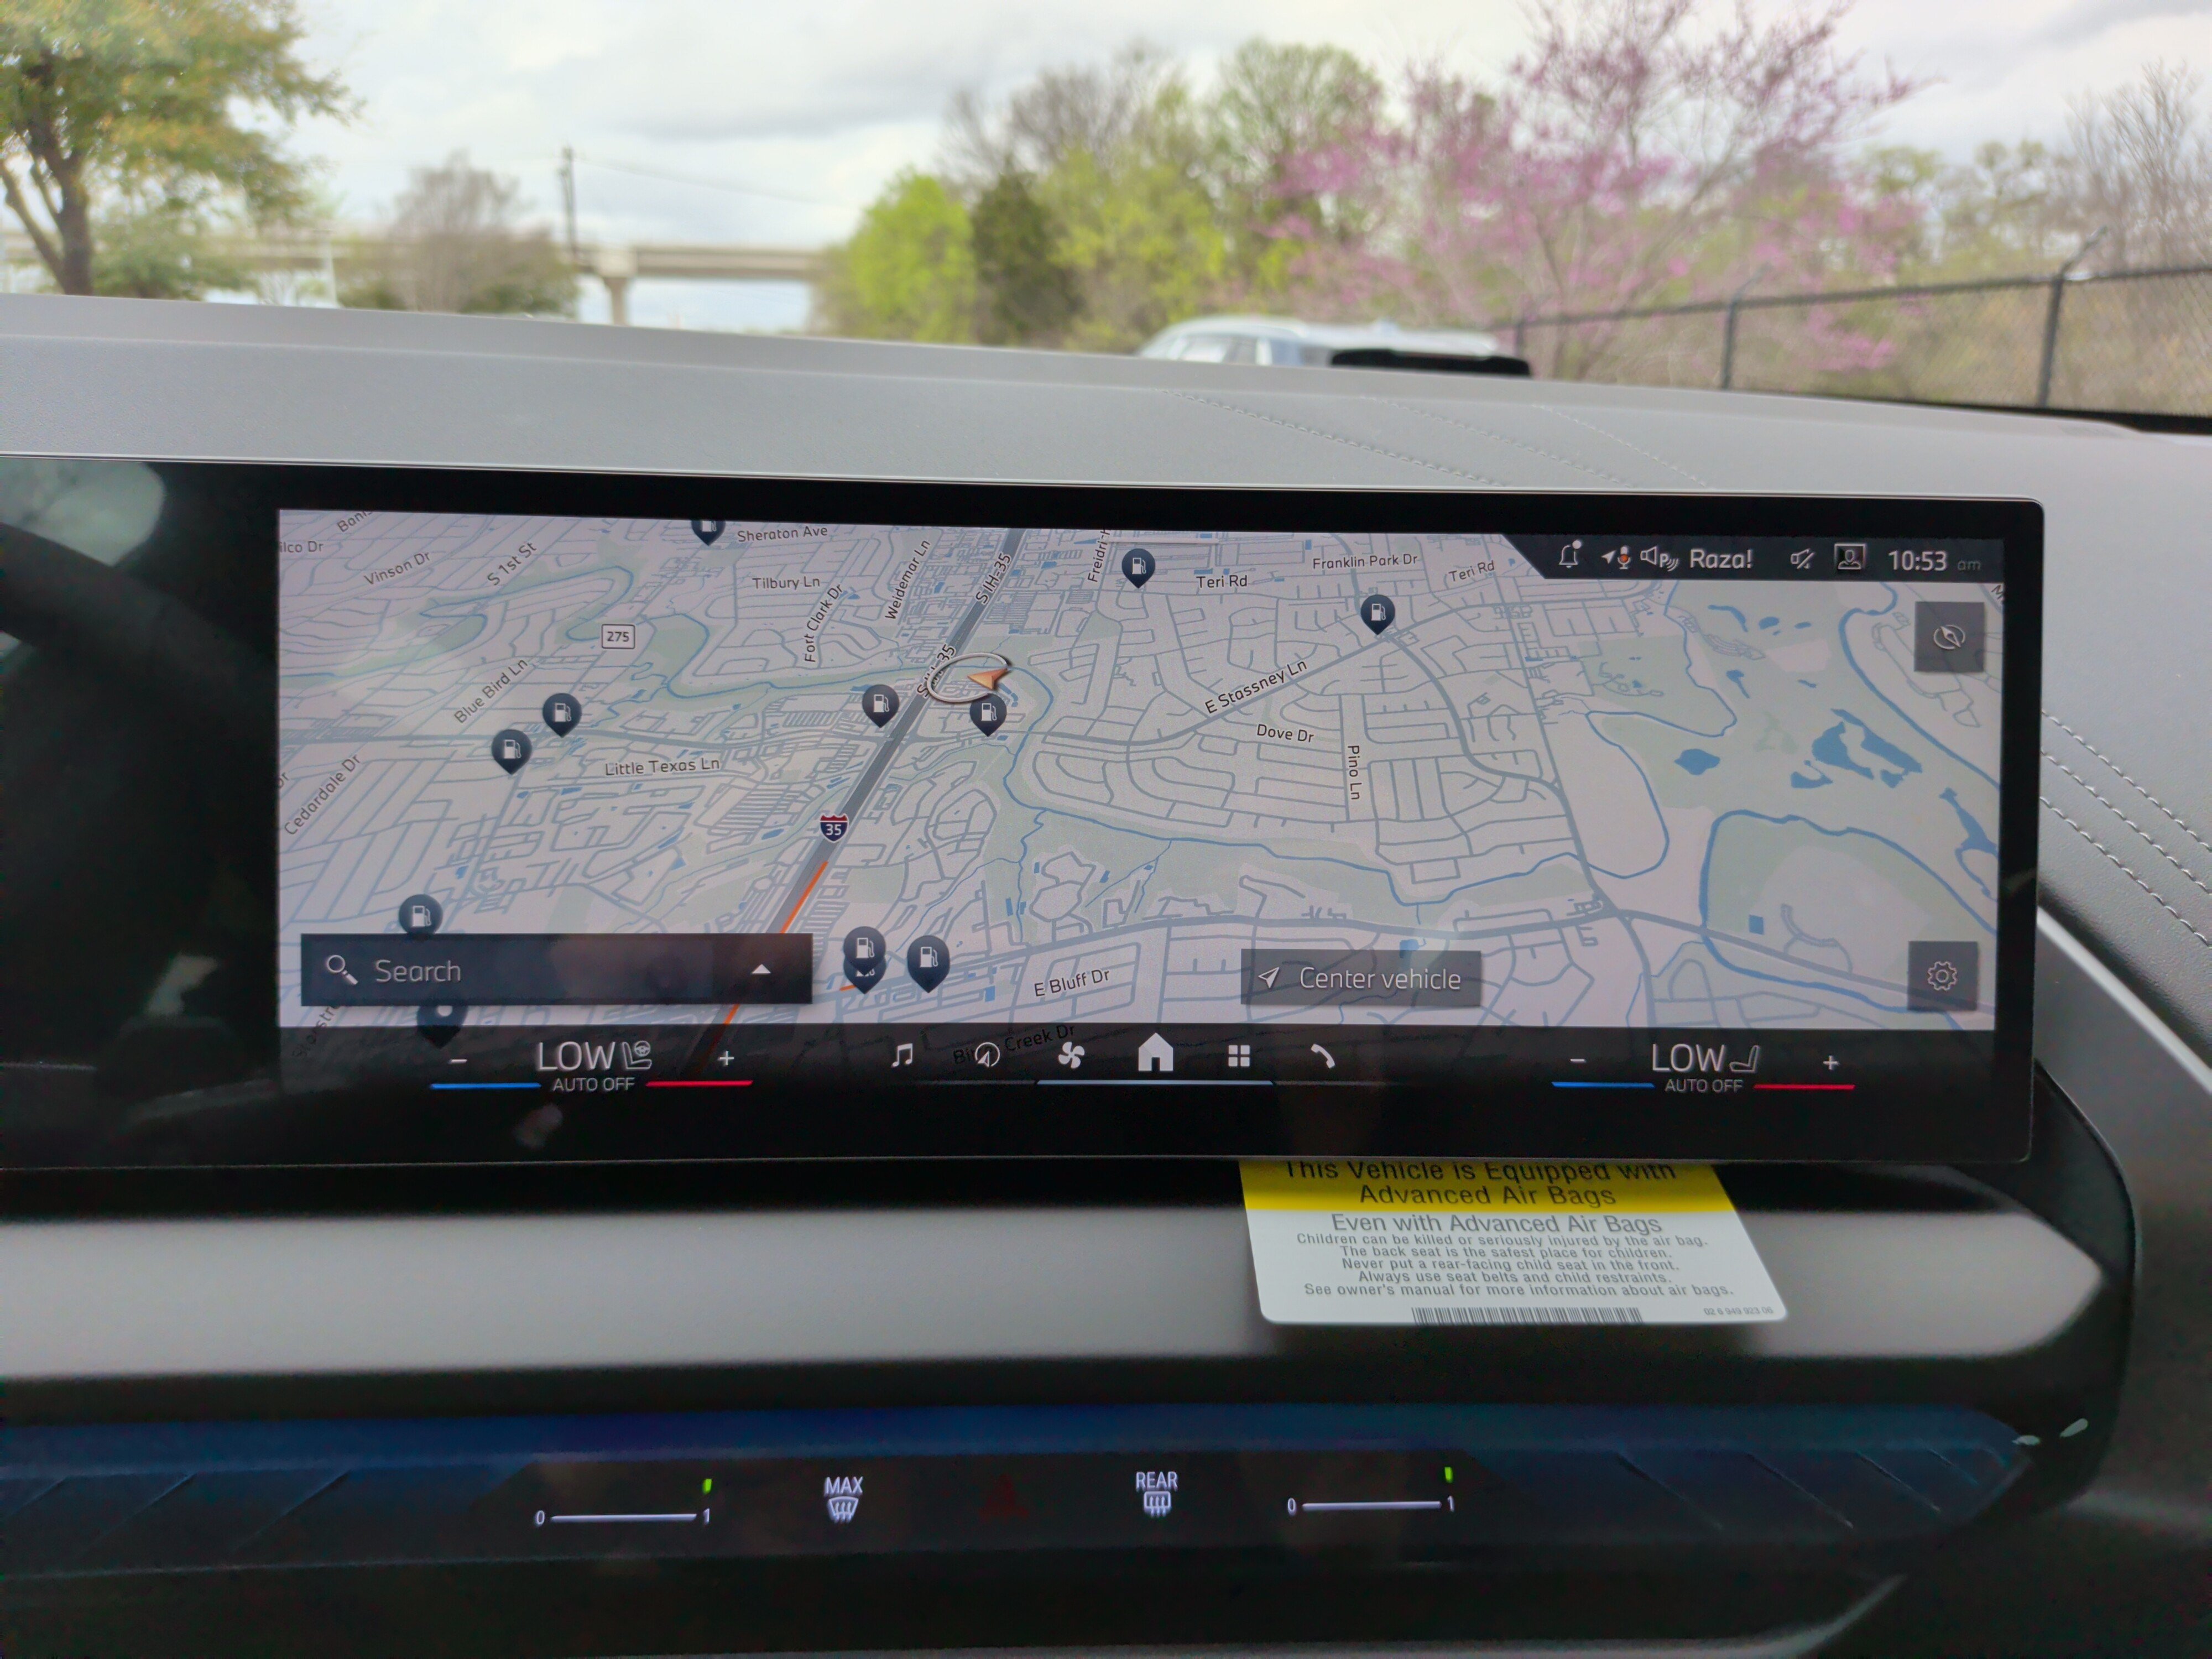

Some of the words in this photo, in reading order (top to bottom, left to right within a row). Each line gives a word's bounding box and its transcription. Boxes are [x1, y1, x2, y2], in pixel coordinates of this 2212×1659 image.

[737, 528, 799, 542] Sheraton
[803, 526, 828, 536] Ave
[279, 541, 302, 552] ilco
[308, 541, 324, 552] Dr
[487, 572, 500, 586] S
[499, 555, 522, 575] 1st
[518, 541, 538, 559] St
[1313, 556, 1365, 569] Franklin
[1370, 555, 1399, 567] Park
[1403, 554, 1418, 565] Dr
[1690, 548, 1752, 569] Raza!
[1888, 550, 1948, 572] 10:53
[1957, 559, 1981, 571] am
[363, 560, 413, 585] Vinson
[414, 552, 431, 566] Dr
[1448, 567, 1475, 582] Teri
[1477, 560, 1495, 573] Rd
[752, 577, 800, 590] Tilbury
[804, 576, 820, 587] Ln
[885, 556, 920, 619] Weidemar
[920, 540, 931, 556] Ln
[975, 591, 988, 604] S
[983, 553, 1011, 592] IH-35
[1196, 576, 1224, 588] Teri
[1229, 575, 1248, 587] Rd
[831, 584, 843, 600] Dr
[807, 598, 832, 631] Clark
[607, 632, 629, 643] 275
[804, 635, 816, 662] Fort
[454, 697, 485, 723] Blue
[482, 672, 511, 698] Bird
[508, 659, 528, 676] Ln
[1204, 700, 1217, 713] E
[1218, 670, 1285, 707] Stassney
[1286, 660, 1307, 676] Ln
[1256, 724, 1293, 740] Dove
[1297, 729, 1314, 743] Dr
[605, 761, 644, 775] Little
[649, 760, 696, 773] Texas
[701, 758, 719, 770] Ln
[1348, 745, 1360, 778] Pino
[284, 773, 346, 834] Cedardale
[342, 754, 360, 772] Dr
[1350, 782, 1362, 800] Ln
[826, 824, 842, 836] 35
[374, 959, 461, 983] Search
[1300, 966, 1375, 989] Center
[1381, 968, 1461, 990] vehicle
[1034, 983, 1046, 997] E
[1049, 971, 1087, 994] Bluff
[1091, 969, 1110, 984] Dr
[1005, 1029, 1052, 1051] Creek
[1056, 1025, 1075, 1039] Dr
[538, 1041, 615, 1071] LOW
[1652, 1044, 1726, 1073] LOW
[553, 1078, 598, 1092] AUTO
[602, 1077, 635, 1091] OFF
[1665, 1079, 1708, 1094] AUTO
[1713, 1079, 1743, 1093] OFF
[1286, 1160, 1338, 1178] This
[1348, 1161, 1444, 1180] Vehicle
[1453, 1162, 1475, 1180] is
[1485, 1162, 1611, 1185] Equipped
[1617, 1164, 1677, 1180] with
[1360, 1185, 1491, 1204] Advanced
[1503, 1186, 1537, 1204] Air
[1547, 1186, 1616, 1208] Bags
[1332, 1213, 1387, 1231] Even
[1392, 1214, 1442, 1231] with
[1450, 1214, 1560, 1232] Advanced
[1568, 1215, 1597, 1232] Air
[1603, 1215, 1662, 1236] Bags
[1297, 1233, 1356, 1244] Children
[1363, 1236, 1387, 1244] can
[1392, 1234, 1409, 1244] be
[1414, 1234, 1452, 1244] killed
[1458, 1237, 1472, 1245] or
[1478, 1235, 1542, 1248] seriously
[1548, 1235, 1599, 1247] injured
[1603, 1235, 1620, 1248] by
[1625, 1236, 1647, 1245] the
[1653, 1236, 1671, 1245] air
[1675, 1235, 1708, 1247] bag.
[1340, 1245, 1367, 1256] The
[1373, 1245, 1406, 1257] back
[1411, 1246, 1441, 1257] seat
[1446, 1246, 1458, 1257] is
[1463, 1247, 1486, 1257] the
[1491, 1247, 1536, 1258] safest
[1540, 1247, 1577, 1259] place
[1582, 1248, 1602, 1258] for
[1608, 1248, 1672, 1258] children.
[1342, 1258, 1384, 1269] Never
[1390, 1259, 1414, 1271] put
[1418, 1260, 1427, 1269] a
[1432, 1259, 1511, 1271] rear-facing
[1517, 1259, 1552, 1270] child
[1557, 1260, 1588, 1270] seat
[1592, 1260, 1605, 1270] in
[1610, 1260, 1634, 1271] the
[1637, 1260, 1679, 1270] front.
[1359, 1271, 1410, 1284] Always
[1416, 1273, 1442, 1281] use
[1446, 1272, 1477, 1282] seat
[1482, 1271, 1518, 1282] belts
[1523, 1272, 1550, 1282] and
[1555, 1272, 1590, 1282] child
[1596, 1272, 1672, 1283] restraints.
[1304, 1283, 1332, 1295] See
[1337, 1284, 1395, 1295] owner's
[1401, 1284, 1455, 1295] manual
[1459, 1284, 1481, 1295] for
[1486, 1286, 1525, 1295] more
[1528, 1284, 1617, 1296] information
[1621, 1285, 1665, 1296] about
[1669, 1285, 1687, 1295] air
[1691, 1285, 1734, 1296] bags.
[824, 1477, 864, 1495] MAX
[1135, 1471, 1178, 1491] REAR
[1287, 1498, 1297, 1515] 0
[1447, 1495, 1455, 1512] 1
[534, 1510, 546, 1525] 0
[702, 1508, 711, 1524] 1
